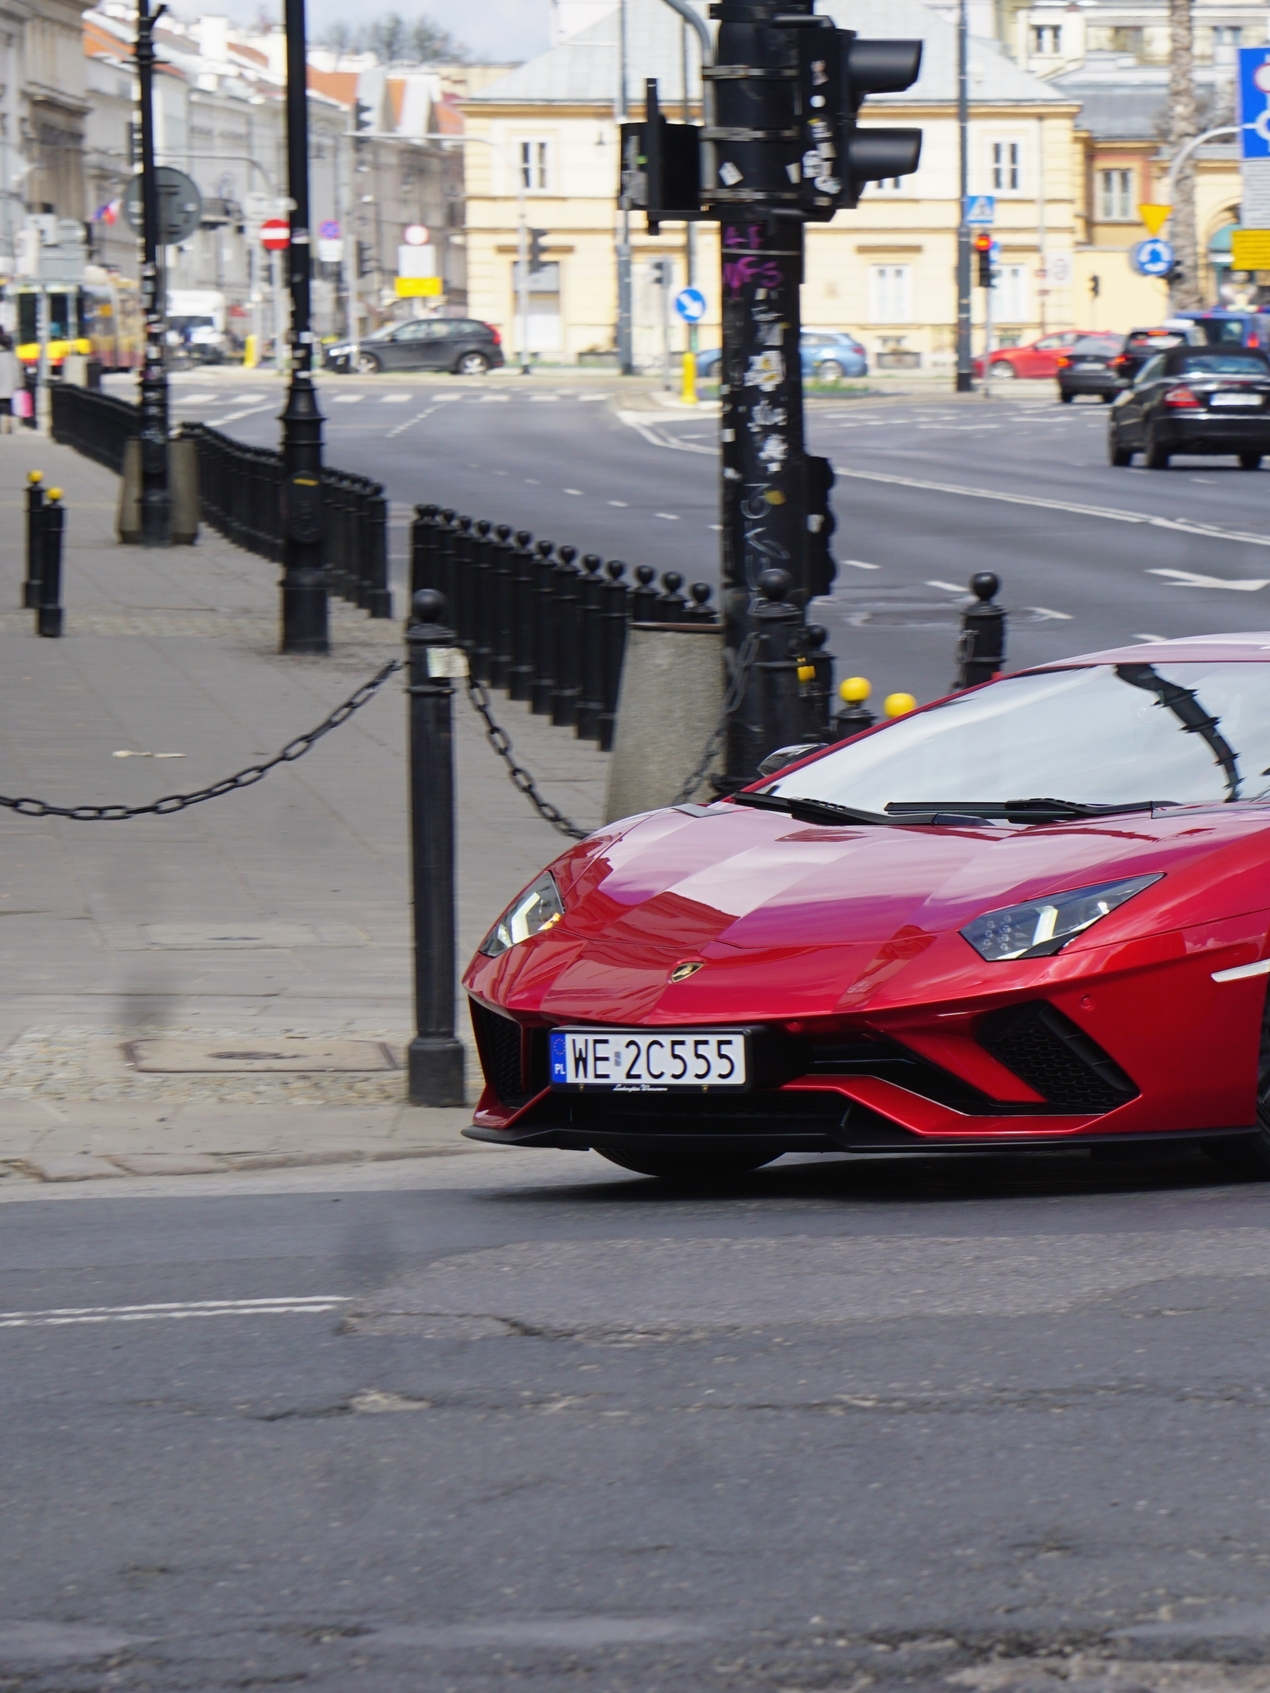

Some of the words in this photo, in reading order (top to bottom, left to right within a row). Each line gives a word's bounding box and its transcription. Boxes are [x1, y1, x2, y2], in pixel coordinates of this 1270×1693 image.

[554, 1063, 566, 1075] PL
[572, 1038, 611, 1079] WE
[625, 1039, 736, 1080] 2C555
